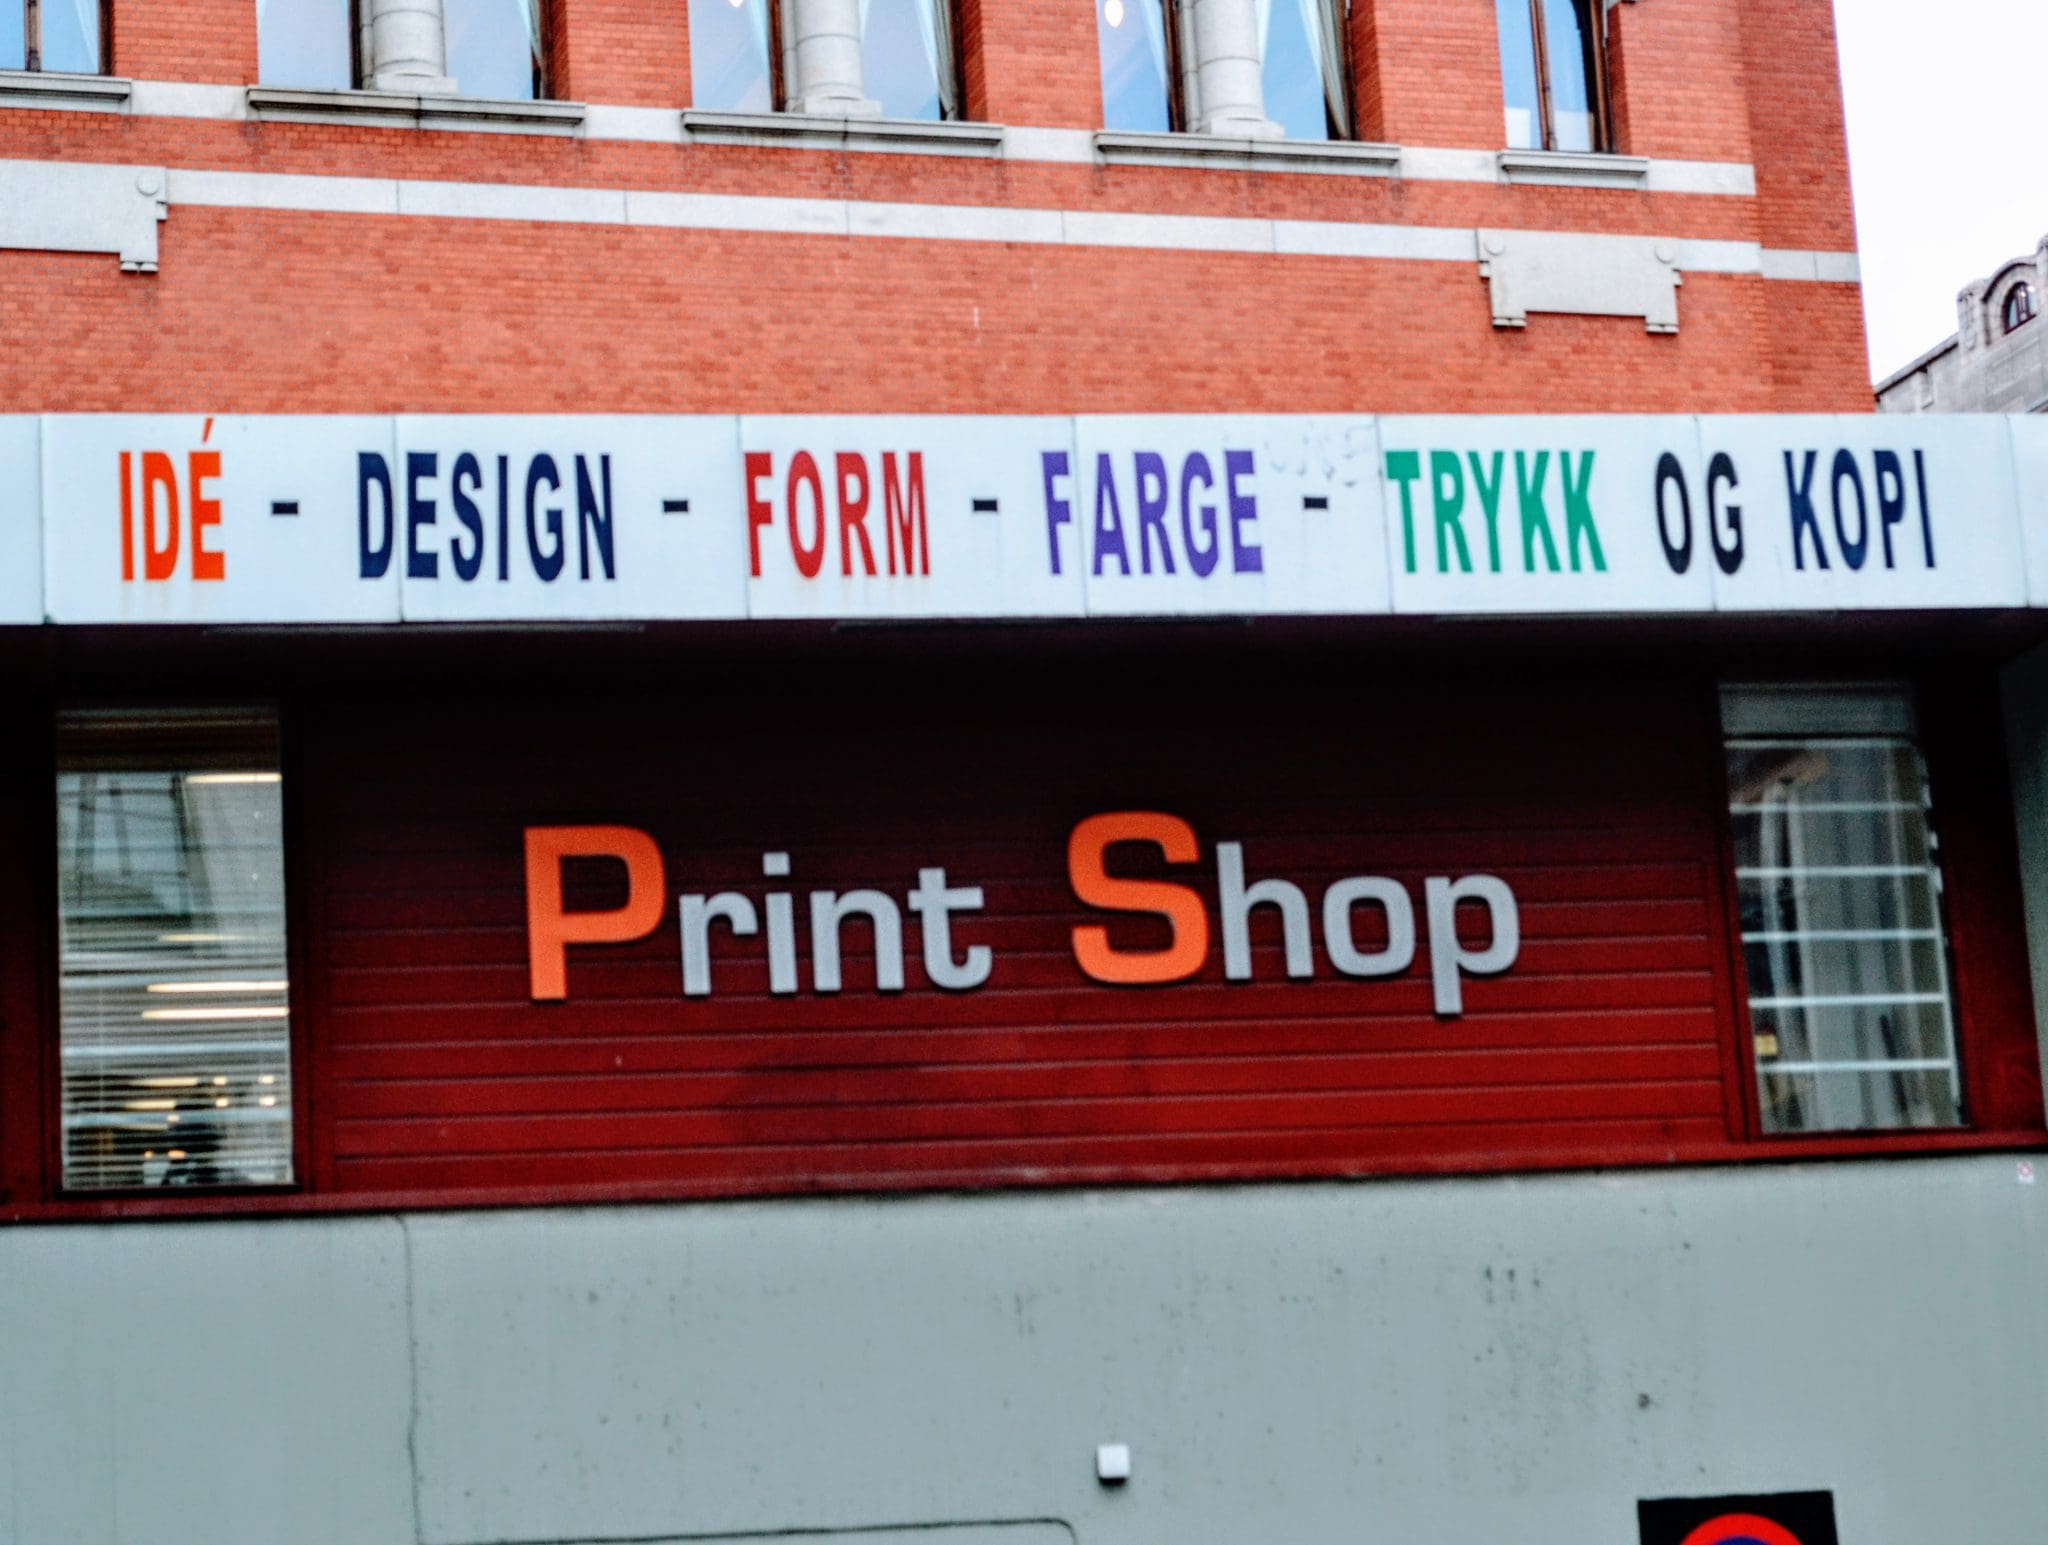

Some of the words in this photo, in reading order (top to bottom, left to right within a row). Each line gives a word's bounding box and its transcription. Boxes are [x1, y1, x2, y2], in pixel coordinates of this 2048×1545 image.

[119, 419, 225, 582] IDÉ
[270, 500, 299, 516] -
[357, 451, 617, 584] DESIGN
[661, 499, 689, 514] -
[744, 451, 930, 579] FORM
[972, 498, 999, 513] -
[1041, 450, 1263, 578] FARGE
[1302, 496, 1329, 510] -
[1384, 449, 1607, 574] TRYKK
[1654, 451, 1745, 576] OG
[1782, 447, 1936, 572] KOPI
[524, 824, 993, 999] Print
[1067, 811, 1520, 1014] Shop
